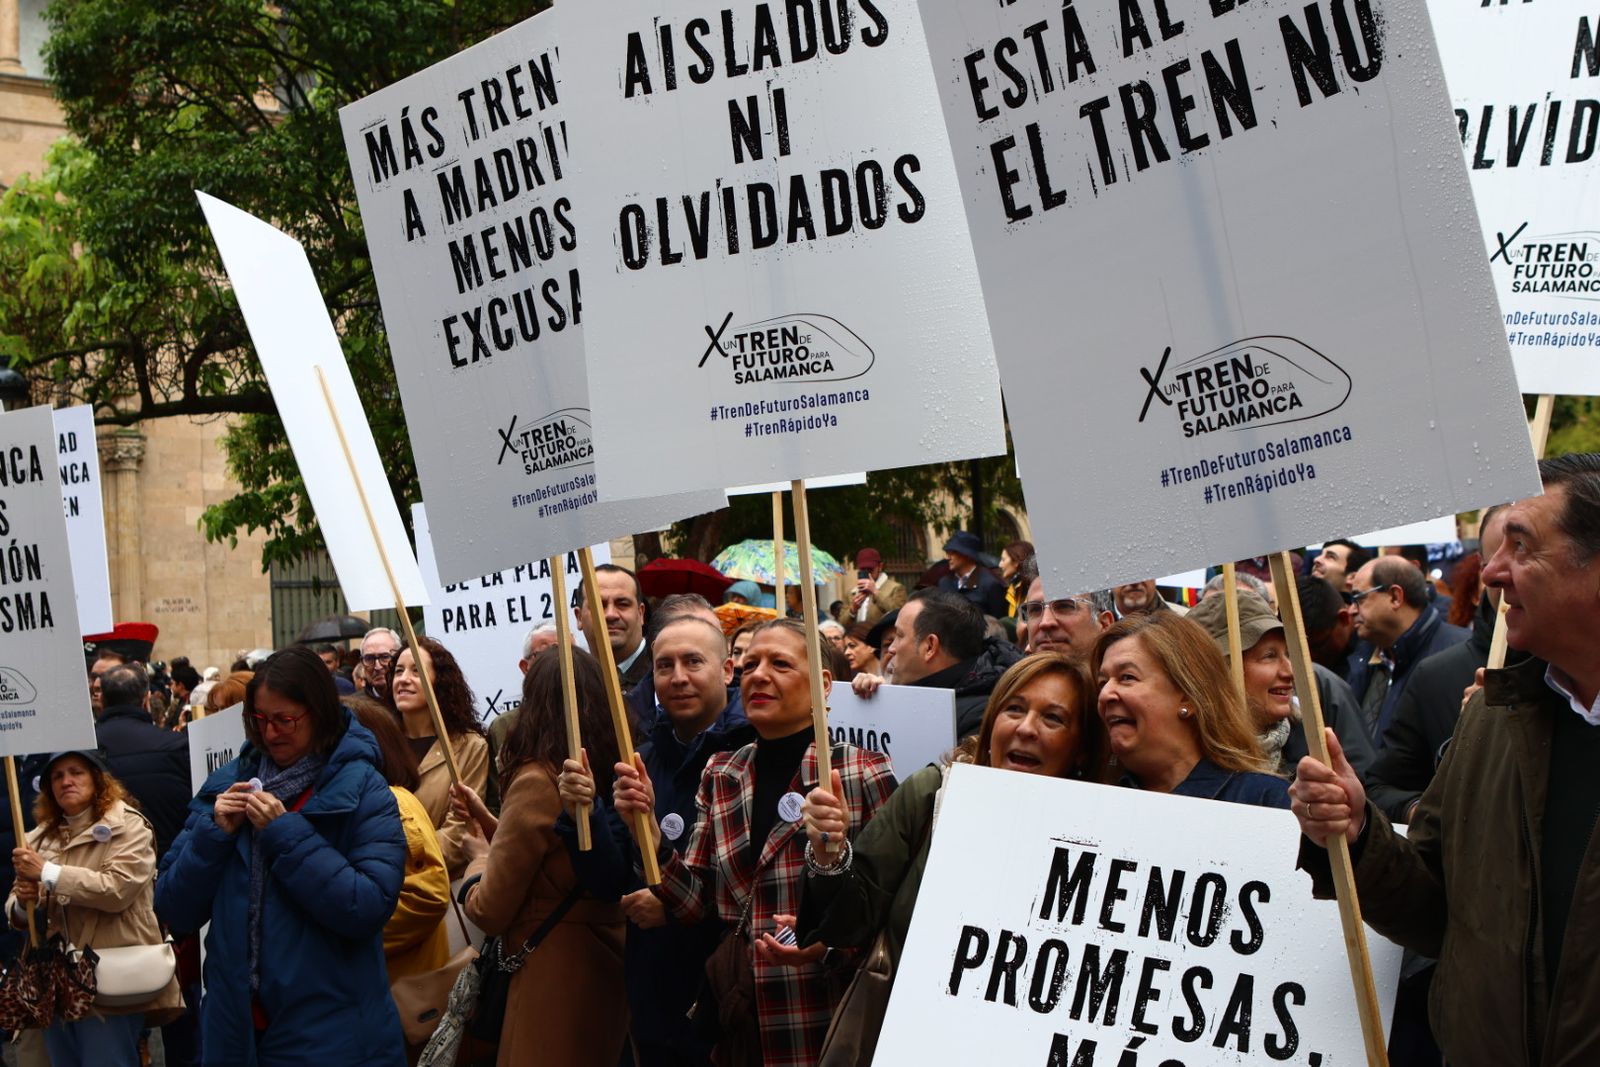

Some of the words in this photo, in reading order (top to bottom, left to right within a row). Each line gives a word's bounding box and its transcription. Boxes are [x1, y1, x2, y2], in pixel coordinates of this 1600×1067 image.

[624, 0, 890, 99] AISLADOS
[964, 0, 1097, 124] ESTÁ
[364, 105, 446, 184] MÁS
[457, 46, 560, 142] TREN
[727, 87, 791, 165] NI
[989, 122, 1067, 224] EL
[1079, 38, 1258, 187] TREN
[1278, 0, 1382, 108] NO
[403, 188, 427, 243] A
[436, 121, 568, 226] MADRI
[619, 153, 926, 271] OLVIDADOS
[448, 197, 577, 294] MENOS
[1513, 263, 1593, 279] FUTURO
[1523, 242, 1587, 262] TREN
[698, 311, 733, 368] X
[723, 340, 738, 351] UN
[734, 326, 799, 353] TREN
[799, 335, 812, 344] DE
[732, 345, 810, 371] FUTURO
[810, 351, 830, 360] PARA
[734, 359, 834, 385] SALAMANCA
[1138, 346, 1171, 423] X
[1164, 382, 1181, 396] UN
[1176, 353, 1255, 398] TREN
[1254, 362, 1271, 377] DE
[710, 389, 870, 421] #TrenDeFuturoSalamanca
[745, 413, 838, 438] #TrenRápidoYa
[1176, 378, 1270, 422] FUTURO
[1270, 381, 1296, 395] PARA
[1182, 392, 1303, 438] SALAMANCA
[498, 414, 518, 466] X
[520, 419, 567, 449] TREN
[566, 425, 577, 435] DE
[521, 435, 577, 464] FUTURO
[524, 445, 594, 476] SALAMANCA
[1160, 425, 1352, 488] #TrenDeFuturoSalamanca
[1204, 463, 1316, 505] #TrenRápidoYa
[441, 601, 498, 634] PARA
[507, 595, 532, 624] EL
[1038, 846, 1271, 956] MENOS
